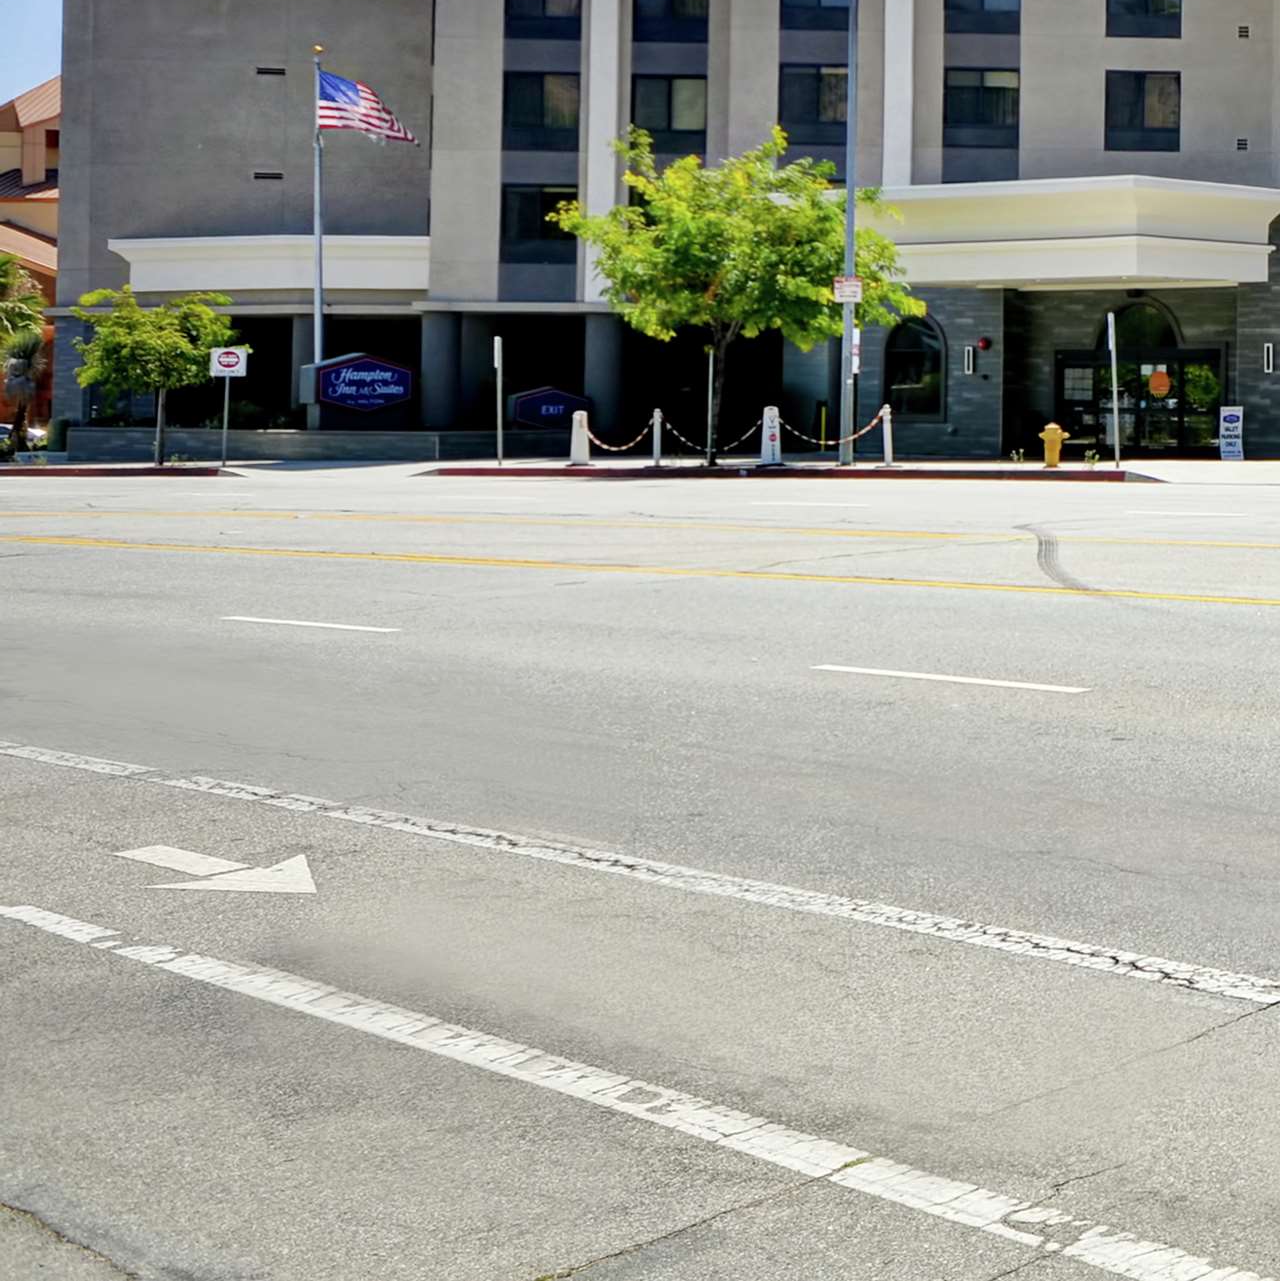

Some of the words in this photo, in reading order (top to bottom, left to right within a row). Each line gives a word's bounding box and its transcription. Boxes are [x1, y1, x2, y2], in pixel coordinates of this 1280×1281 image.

[331, 367, 398, 384] Hampton
[328, 382, 361, 397] Inn
[369, 381, 404, 396] Suites
[541, 404, 565, 415] EXIT
